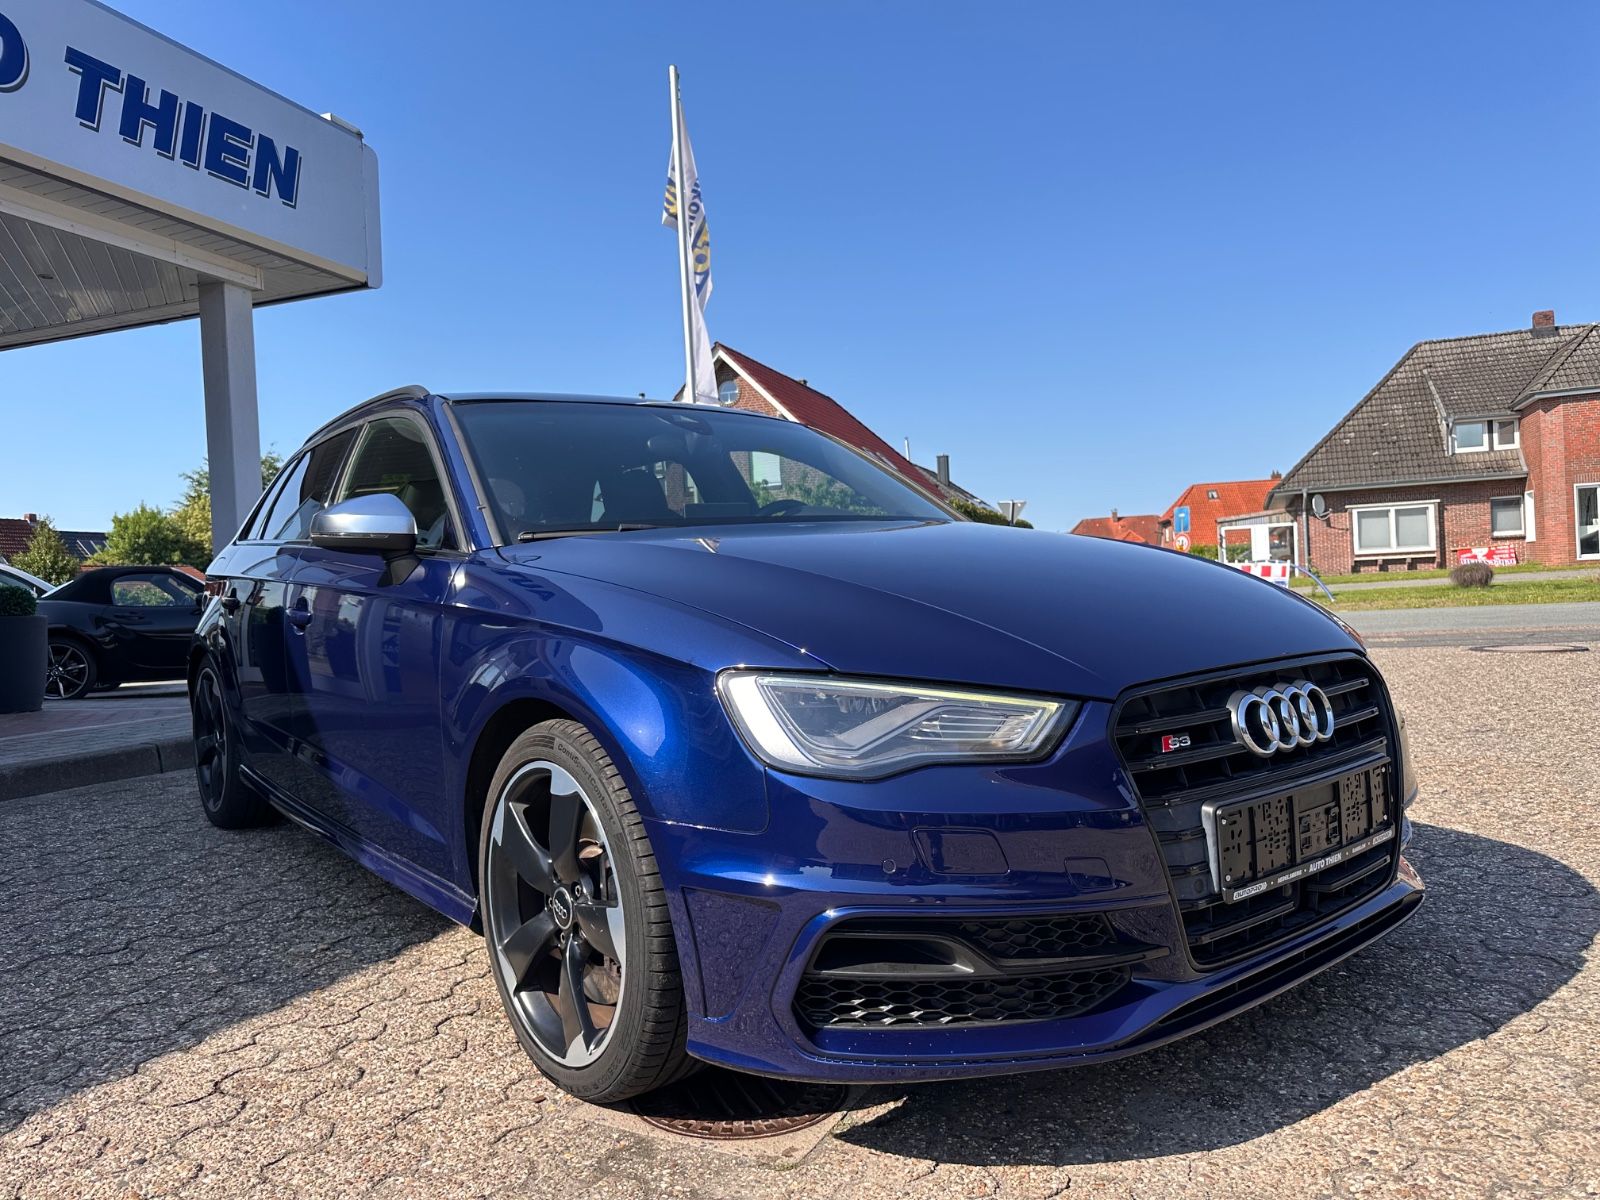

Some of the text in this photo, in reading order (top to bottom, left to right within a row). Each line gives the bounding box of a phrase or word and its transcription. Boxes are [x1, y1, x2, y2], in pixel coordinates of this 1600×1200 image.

[64, 45, 302, 209] THIEN
[1168, 735, 1191, 749] S3
[1309, 858, 1325, 873] AUTO
[1325, 852, 1342, 867] THIEN
